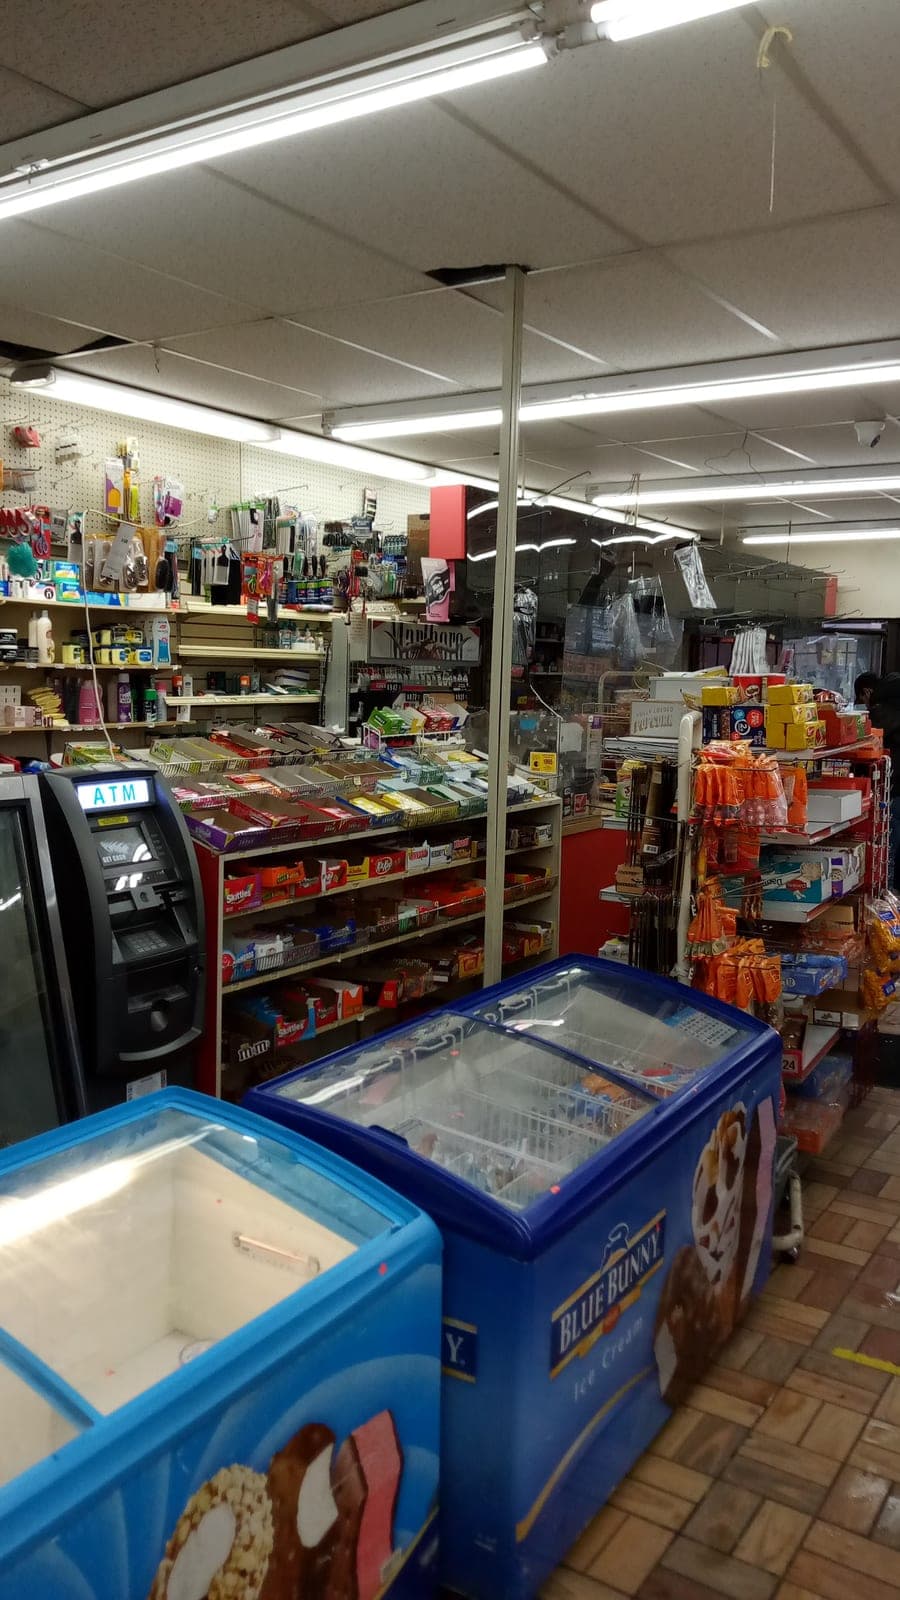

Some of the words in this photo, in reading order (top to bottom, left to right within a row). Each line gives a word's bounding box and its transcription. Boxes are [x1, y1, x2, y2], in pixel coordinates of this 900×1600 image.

[94, 784, 136, 805] ATM
[226, 887, 252, 904] Skittles
[278, 1022, 304, 1037] Skittles
[560, 1283, 604, 1353] BLUE
[607, 1233, 660, 1304] BUNNY
[574, 1368, 595, 1401] Ice
[602, 1316, 643, 1369] Cream
